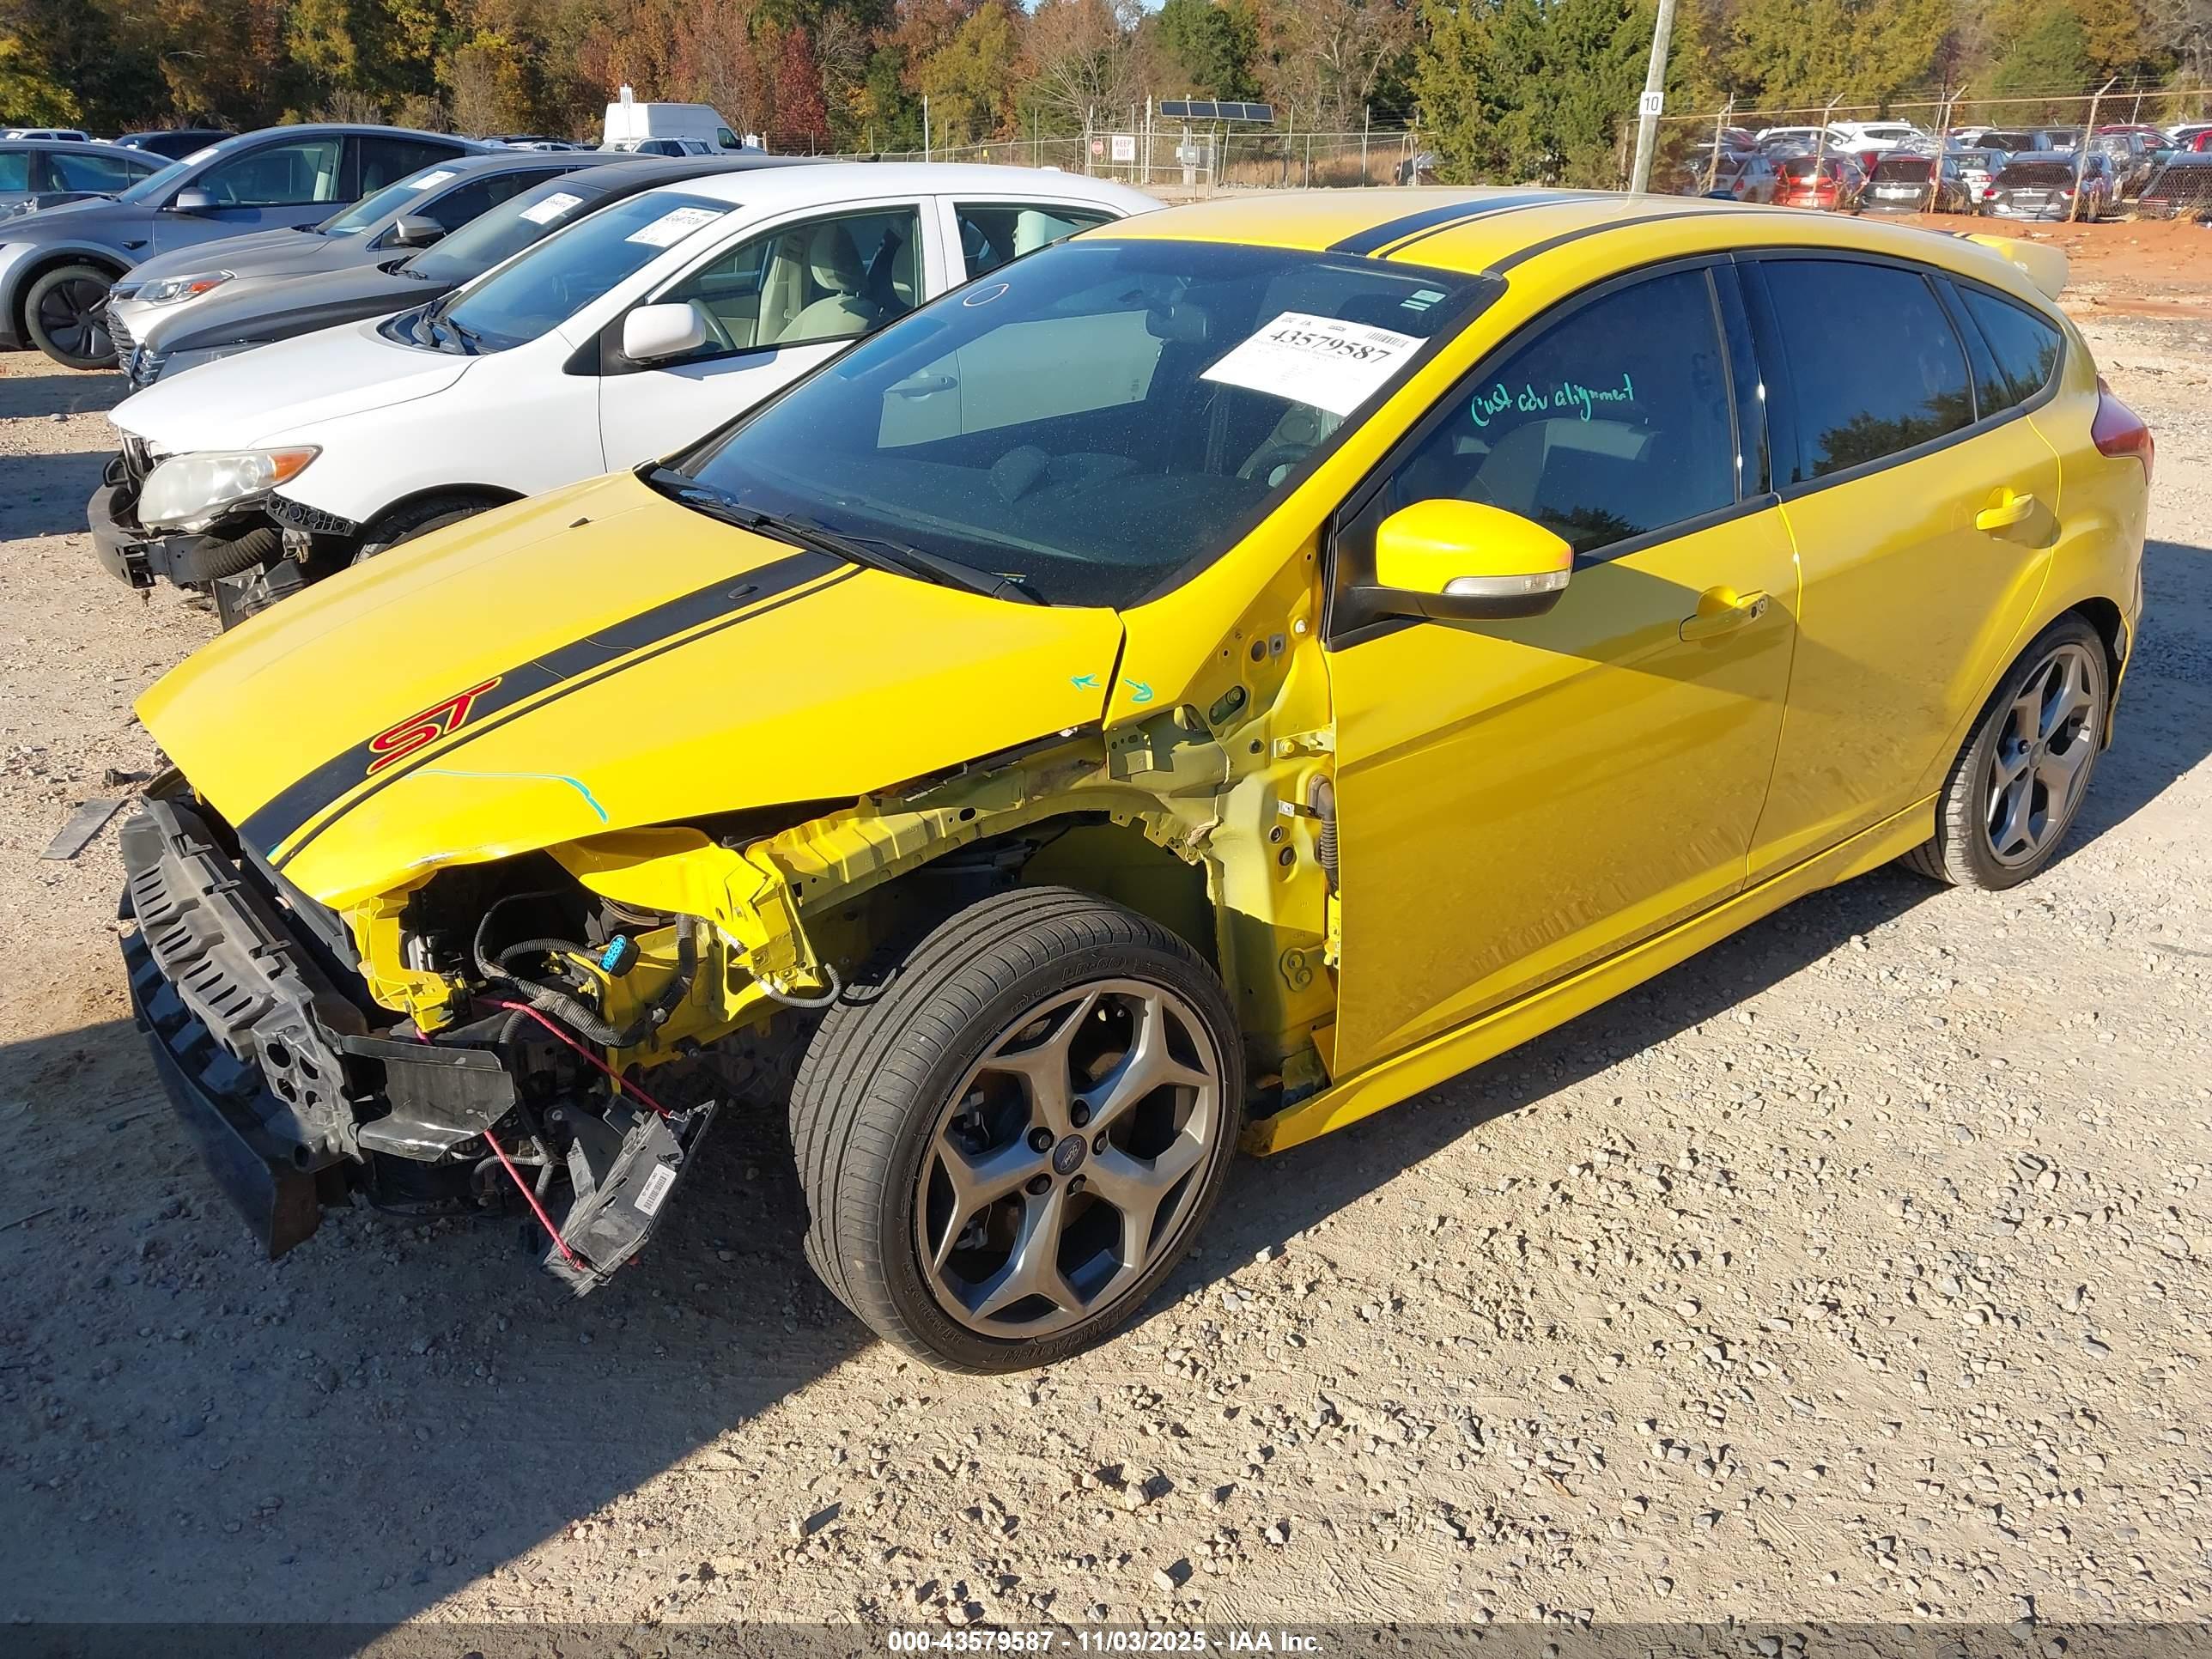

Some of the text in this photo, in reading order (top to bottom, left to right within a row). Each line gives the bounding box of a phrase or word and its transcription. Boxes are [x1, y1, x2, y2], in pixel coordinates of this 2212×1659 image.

[1644, 96, 1659, 111] 10
[1115, 139, 1132, 148] KEEP
[1116, 149, 1130, 157] OUT
[1269, 329, 1393, 364] 43579587
[1471, 383, 1513, 427] Cust
[1554, 374, 1634, 422] alignment
[366, 676, 502, 775] ST
